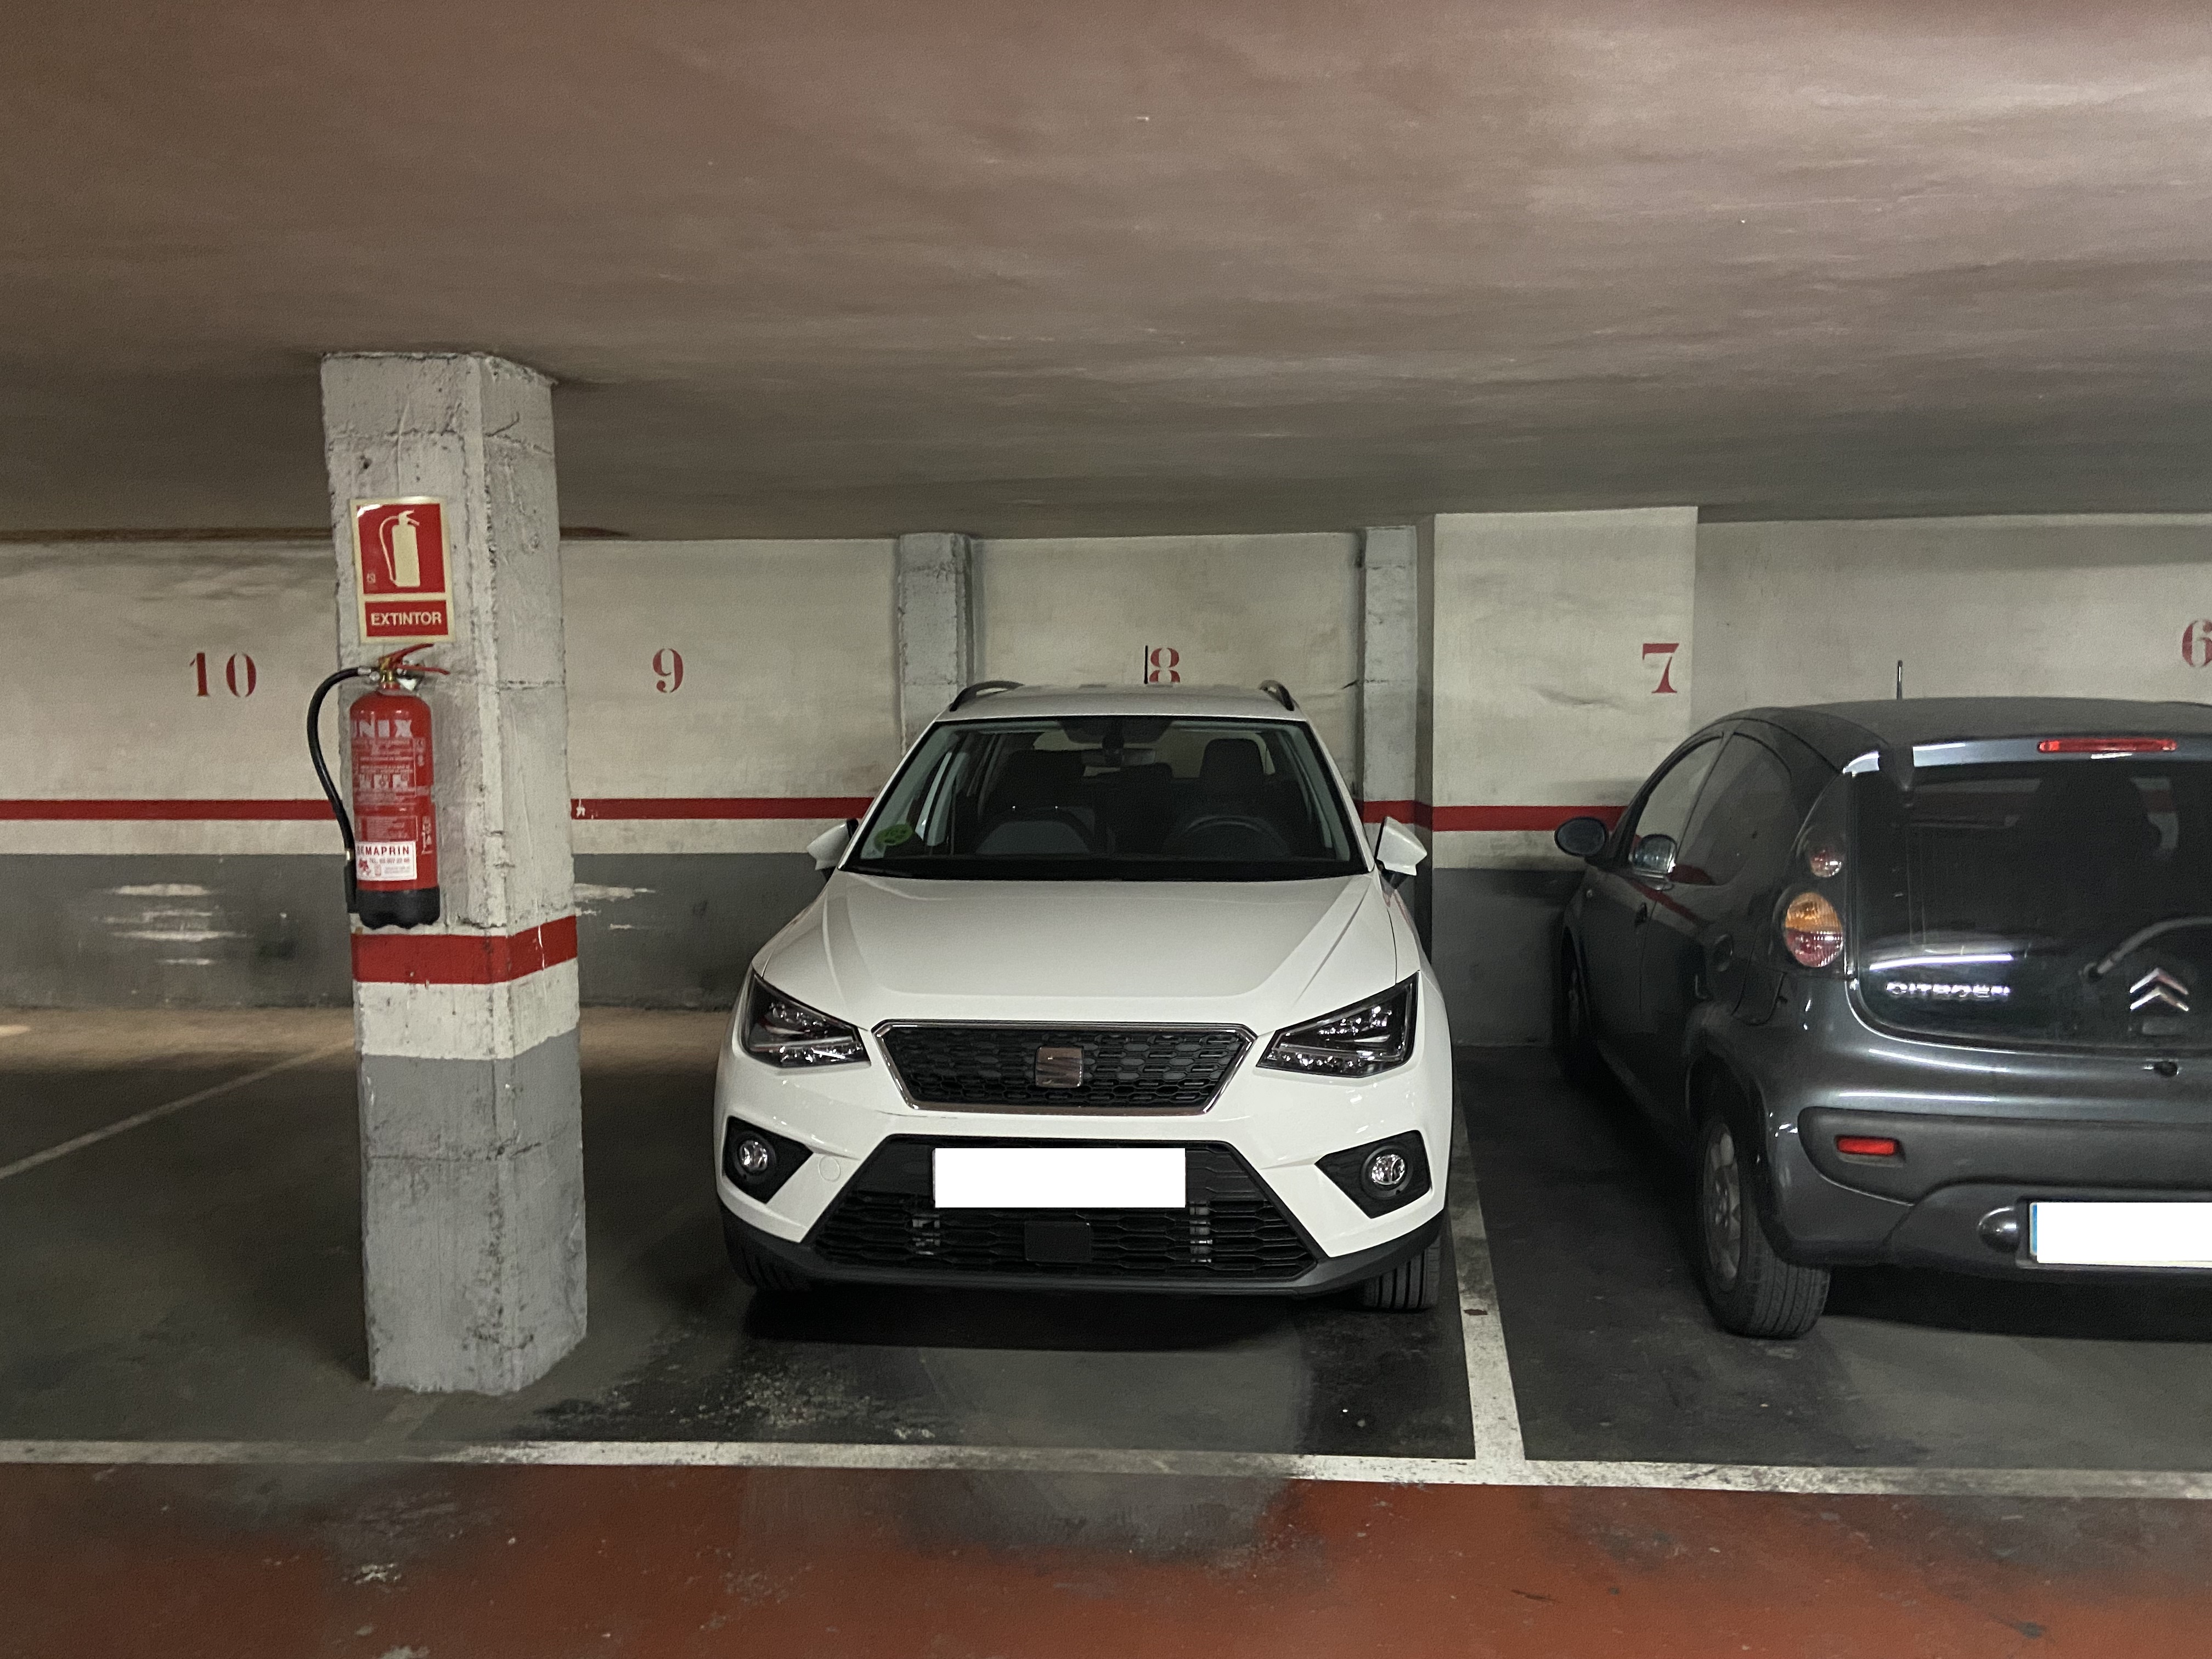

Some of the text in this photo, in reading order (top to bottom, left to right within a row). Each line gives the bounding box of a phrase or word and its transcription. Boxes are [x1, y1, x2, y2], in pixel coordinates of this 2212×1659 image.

[370, 611, 442, 627] EXTINTOR
[1149, 647, 1181, 683] 8
[2181, 619, 2212, 668] 6
[189, 652, 257, 697] 10
[652, 648, 684, 693] 9
[1642, 643, 1680, 693] 7
